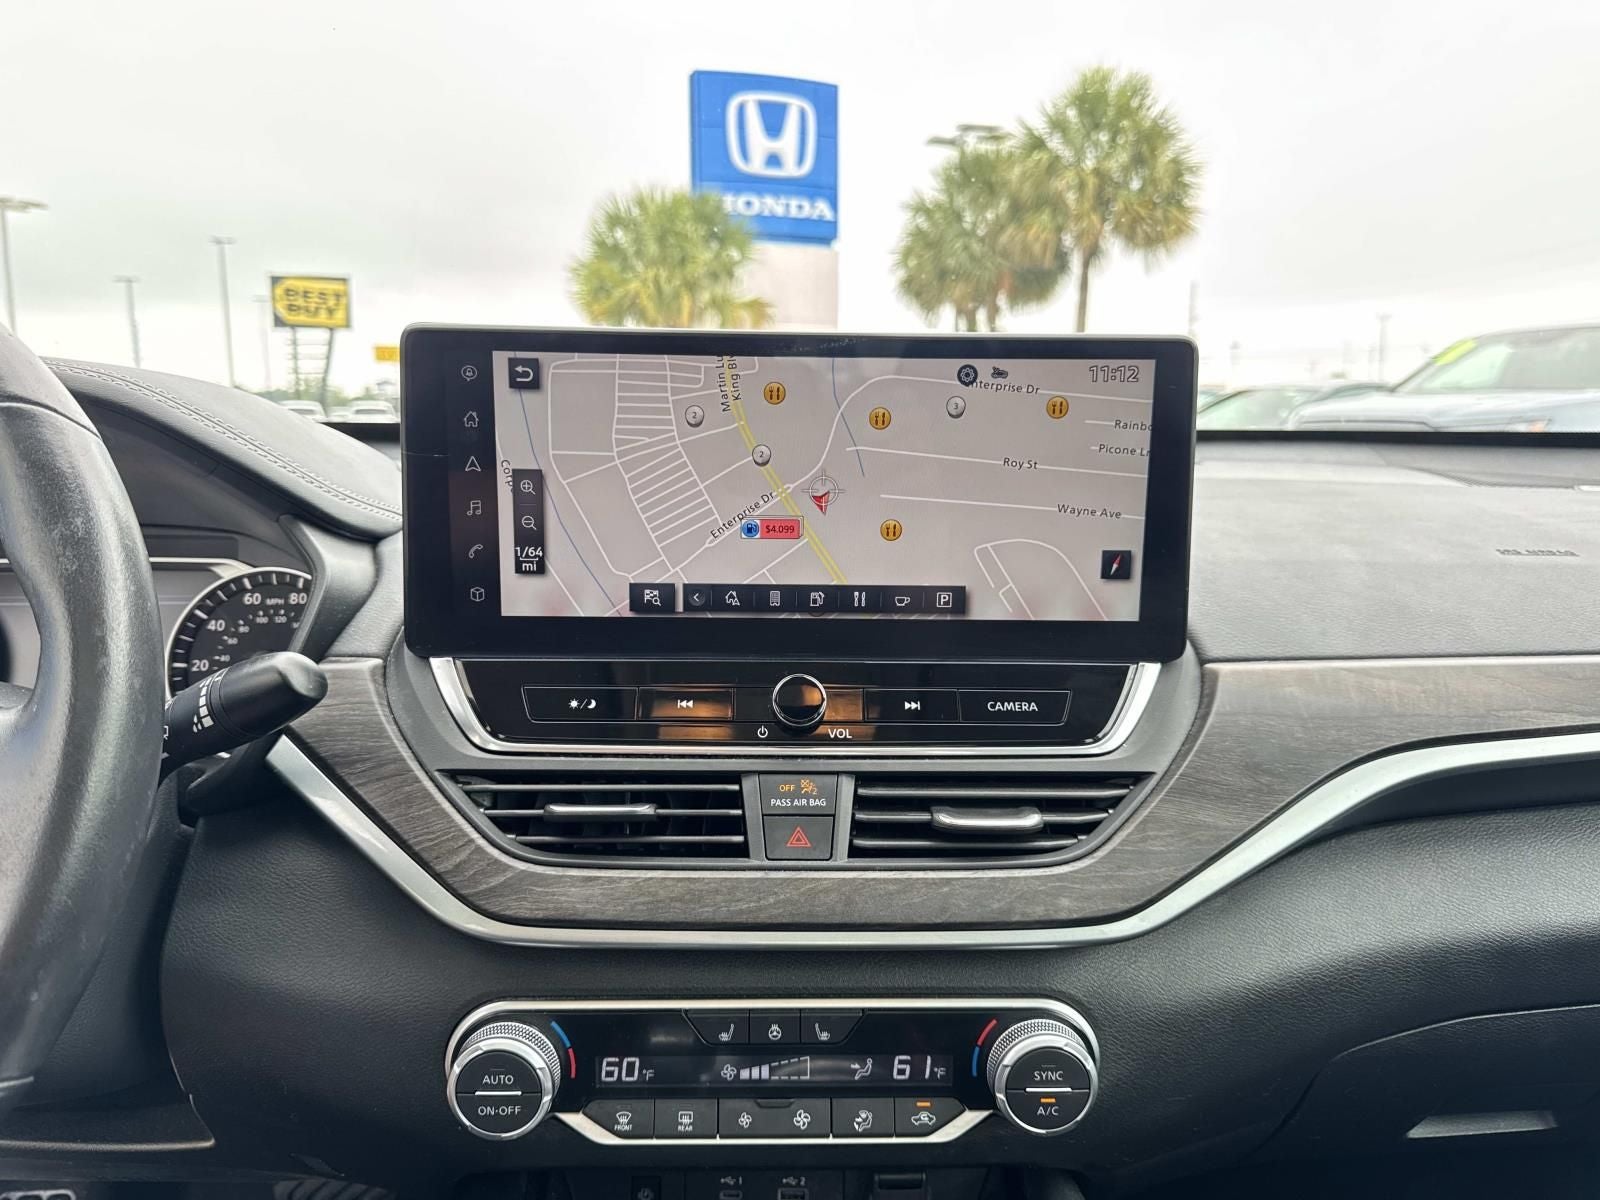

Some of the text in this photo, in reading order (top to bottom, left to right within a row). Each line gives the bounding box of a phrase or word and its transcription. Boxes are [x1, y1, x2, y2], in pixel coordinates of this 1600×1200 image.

[285, 288, 344, 305] BEST
[286, 303, 338, 318] BUY
[1089, 365, 1140, 383] 11:12
[716, 372, 731, 412] Martin
[731, 373, 742, 401] King
[970, 381, 1041, 395] nterprise Dr
[953, 402, 959, 410] 3
[692, 411, 697, 419] 2
[759, 450, 764, 458] 2
[1098, 443, 1137, 456] Picone
[1003, 457, 1038, 471] Roy St
[501, 459, 514, 494] Corp
[710, 491, 776, 539] Enterprise Dr
[1057, 504, 1121, 520] Wayne Ave
[765, 524, 795, 535] $4.099
[515, 546, 543, 558] 1/64
[521, 561, 537, 572] mi
[243, 592, 262, 605] 60
[266, 598, 285, 606] MPH
[289, 592, 308, 605] 80
[207, 619, 226, 632] 40
[191, 660, 209, 672] 20
[987, 701, 1039, 712] CAMERA
[828, 728, 852, 739] VOL
[779, 784, 796, 792] OFF
[770, 798, 827, 807] PASS AIR BAG
[482, 1075, 514, 1086] AUTO
[1033, 1070, 1064, 1082] SYNC
[1037, 1106, 1059, 1117] A/C
[614, 1124, 633, 1132] FRONT
[678, 1124, 693, 1132] REAR
